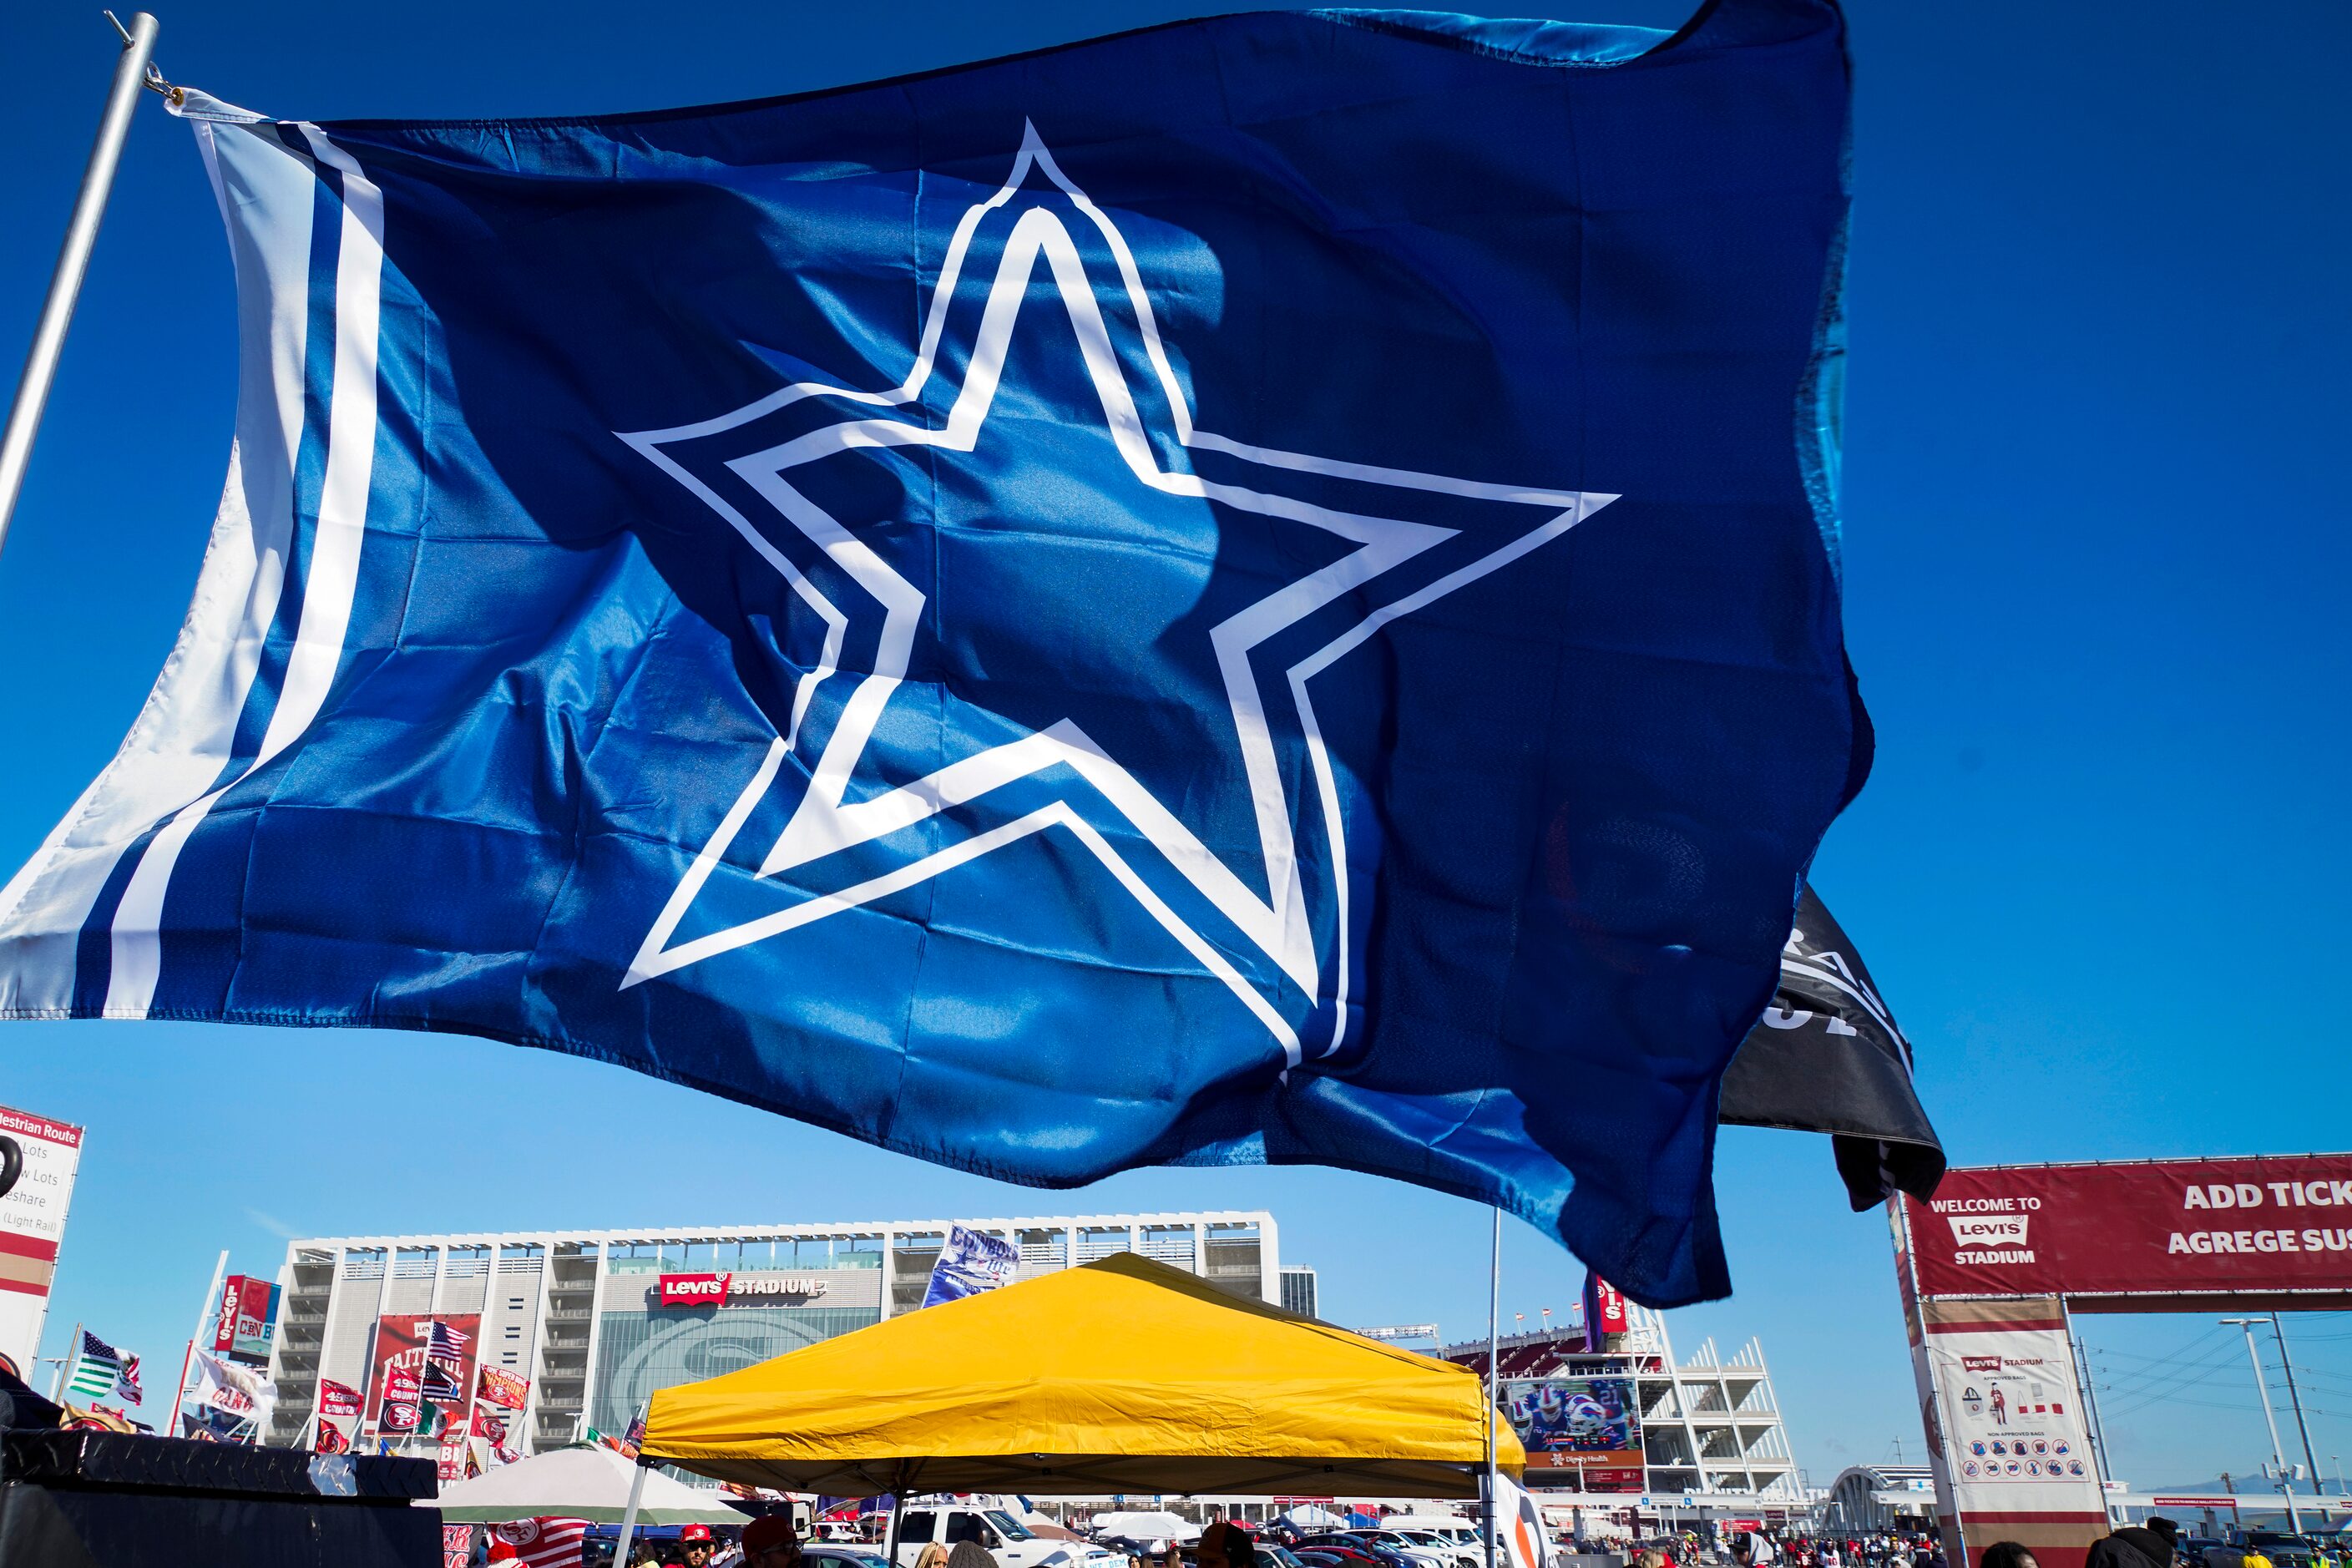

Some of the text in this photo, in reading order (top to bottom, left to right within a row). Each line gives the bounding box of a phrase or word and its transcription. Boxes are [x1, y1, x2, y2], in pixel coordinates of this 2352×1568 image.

[44, 1127, 76, 1144] Route
[23, 1142, 48, 1159] Lots
[33, 1169, 58, 1186] Lots
[5, 1191, 46, 1207] eshare
[1930, 1197, 2041, 1213] WELCOME TO
[2184, 1184, 2263, 1210] ADD
[3, 1212, 58, 1232] (Light Rail)
[951, 1226, 1019, 1261] COWBOYS
[2167, 1230, 2299, 1254] AGREGE
[1955, 1251, 2036, 1265] STADIUM
[734, 1278, 816, 1295] STADIUM
[390, 1389, 418, 1401] COUNT
[485, 1373, 527, 1404] AMPIONS
[1600, 1389, 1619, 1406] 21
[1587, 1454, 1609, 1463] Health
